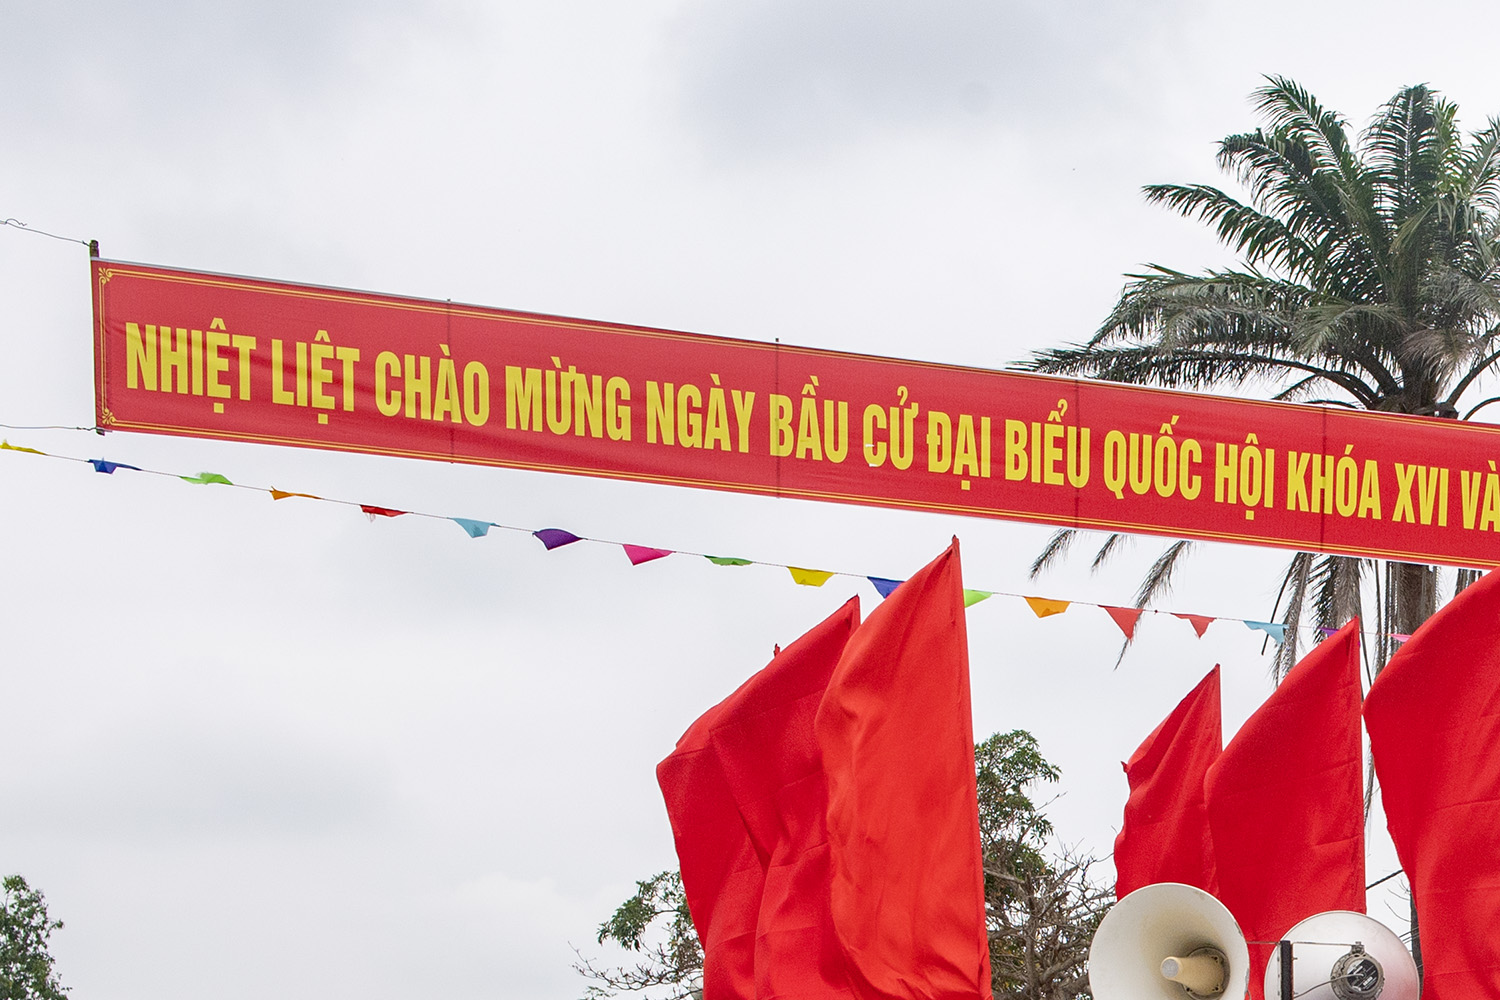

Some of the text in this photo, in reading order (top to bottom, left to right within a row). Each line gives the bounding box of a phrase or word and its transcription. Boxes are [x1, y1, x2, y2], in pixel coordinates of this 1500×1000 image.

[125, 317, 257, 414] NHIỆT
[271, 329, 360, 425] LIỆT
[375, 343, 490, 427] CHÀO
[505, 355, 632, 441] MỪNG
[645, 373, 756, 454] NGÀY
[769, 375, 849, 464] BẦU
[862, 385, 919, 470] CỬ
[926, 410, 991, 491] ĐẠI
[1005, 398, 1091, 489] BIỂU
[1103, 414, 1202, 501] QUỐC
[1214, 432, 1275, 521] HỘI
[1286, 444, 1382, 520] KHÓA
[1391, 462, 1449, 527] XVI
